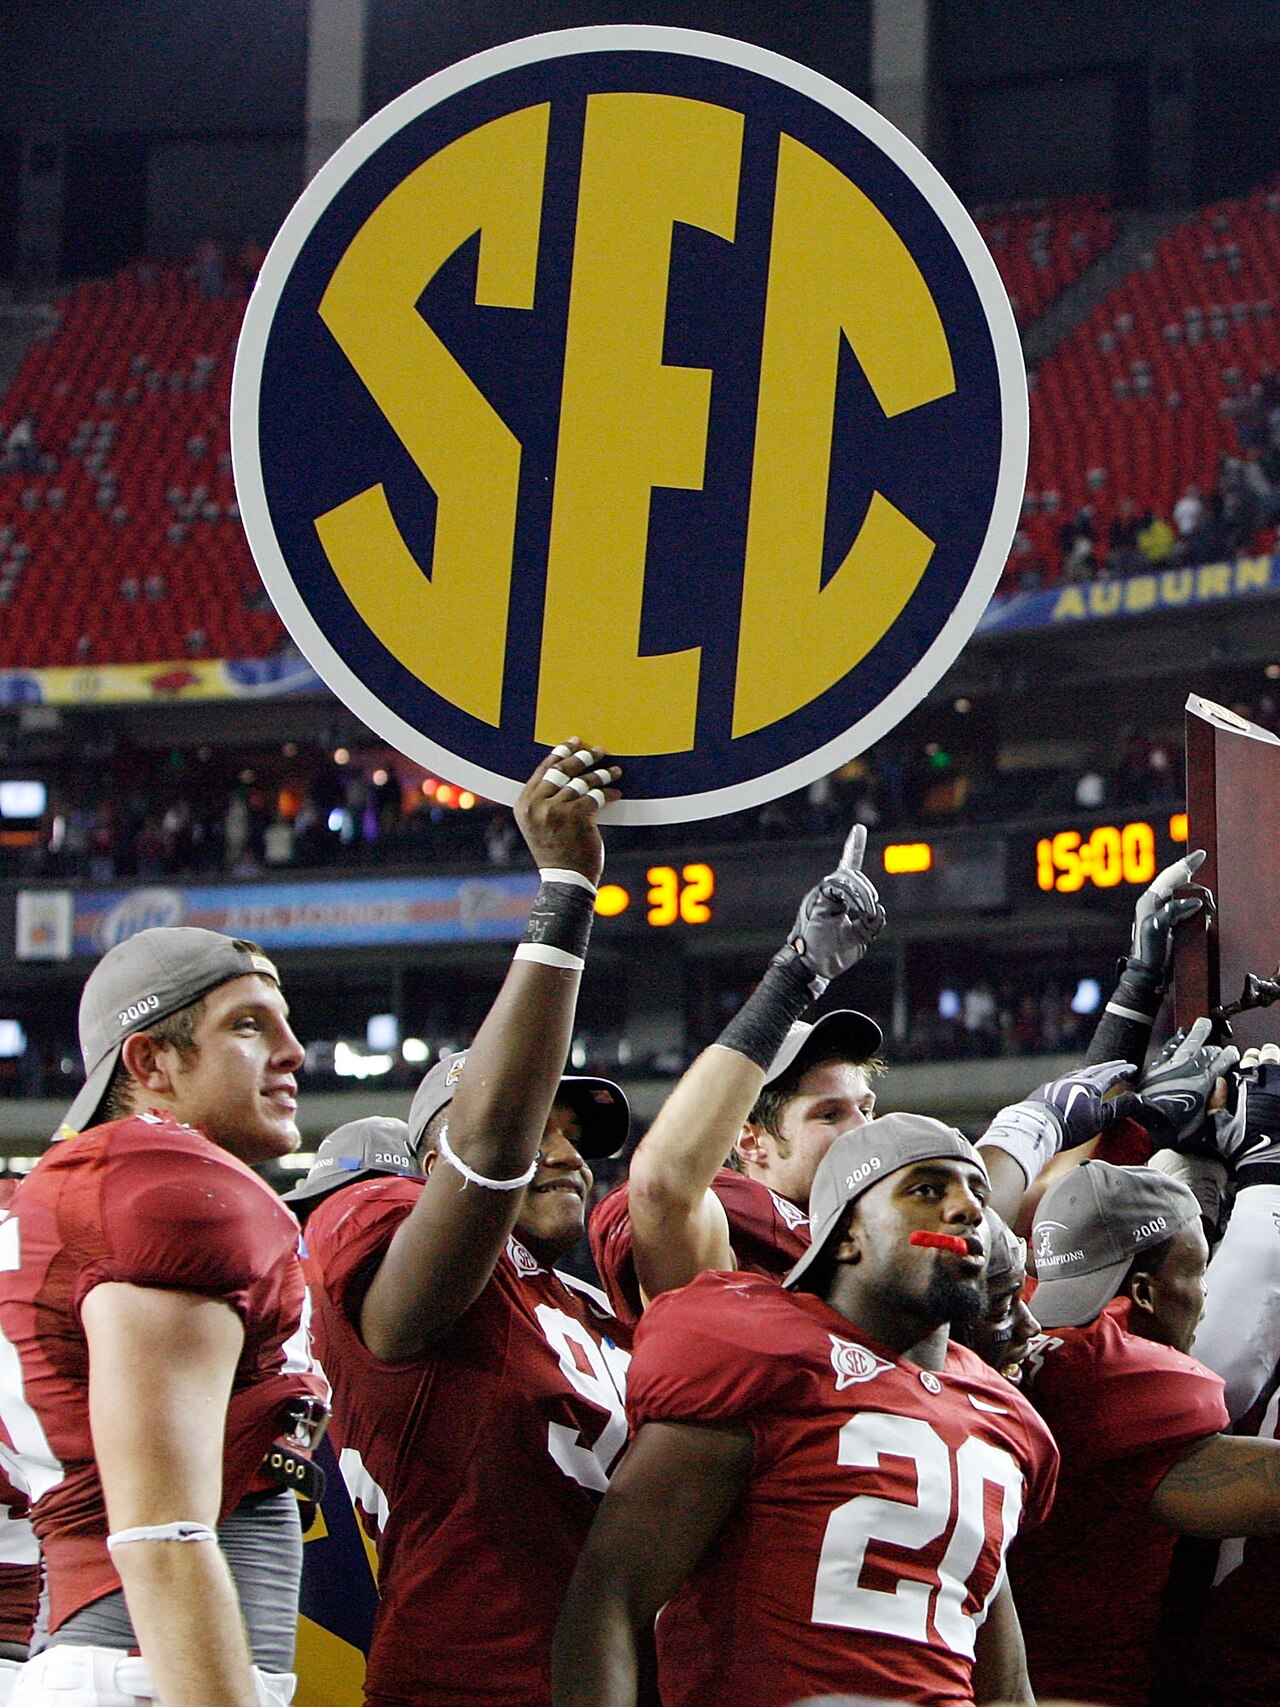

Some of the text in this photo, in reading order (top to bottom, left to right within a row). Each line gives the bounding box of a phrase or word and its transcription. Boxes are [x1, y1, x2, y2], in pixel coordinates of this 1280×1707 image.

[316, 92, 955, 756] SEC
[1053, 556, 1272, 622] AUBURN
[1037, 822, 1156, 893] 15:00
[647, 863, 715, 927] 32
[118, 995, 160, 1026] 2009
[375, 1153, 410, 1168] 2009
[845, 1157, 881, 1190] 2009
[1132, 1216, 1167, 1242] 2009
[845, 1353, 869, 1375] SEC
[811, 1411, 1024, 1663] 20
